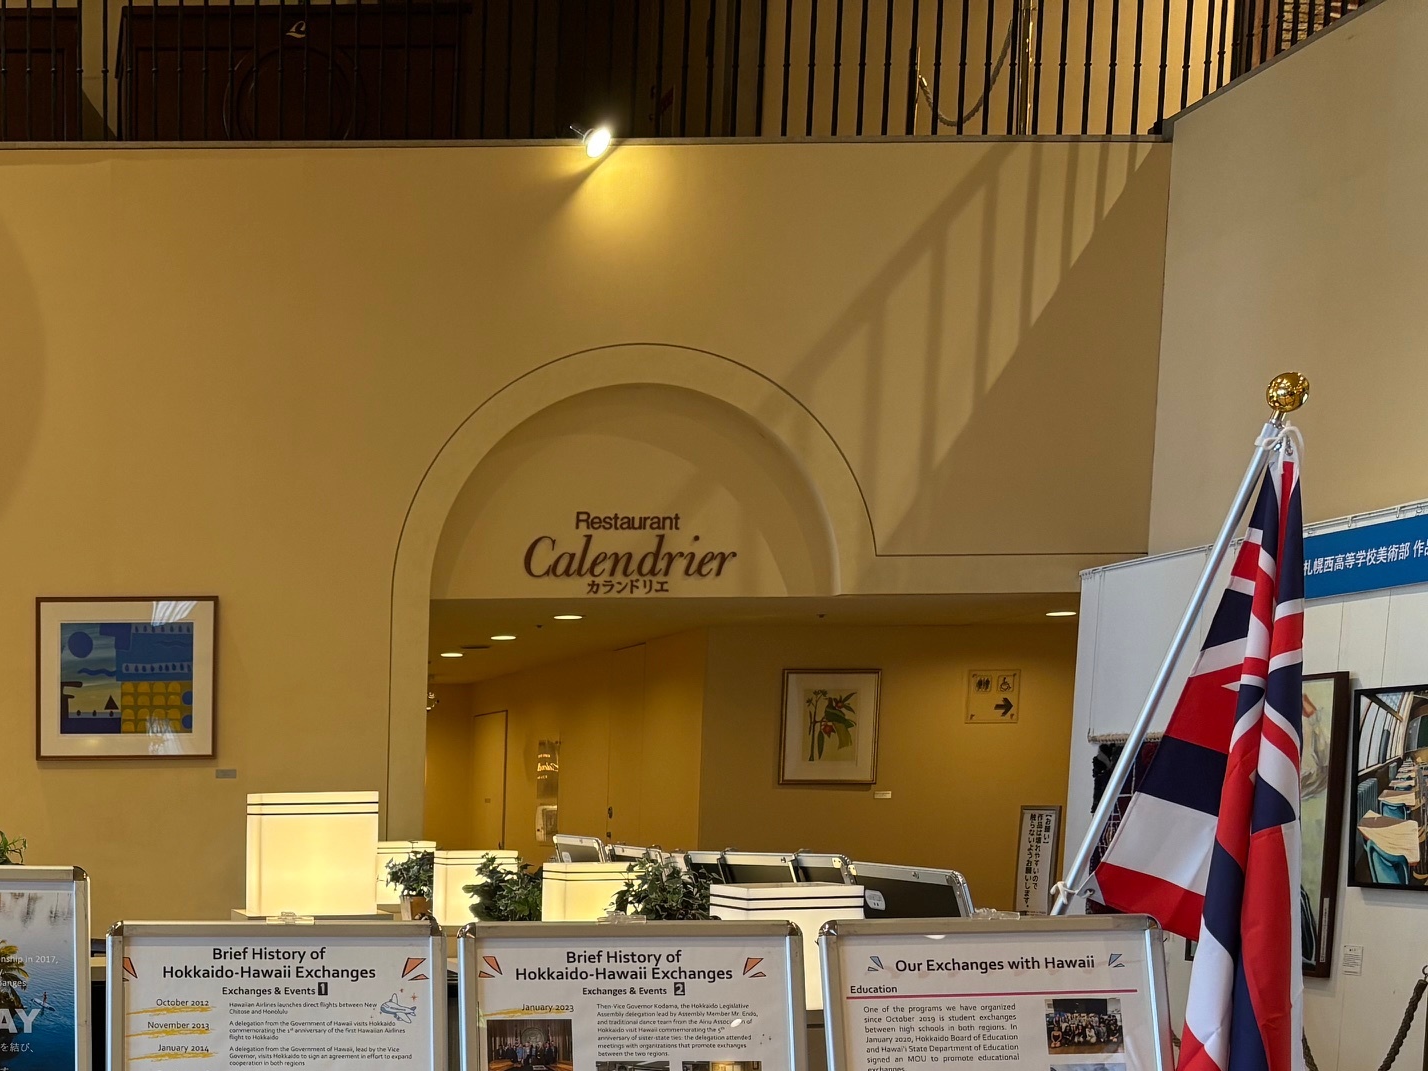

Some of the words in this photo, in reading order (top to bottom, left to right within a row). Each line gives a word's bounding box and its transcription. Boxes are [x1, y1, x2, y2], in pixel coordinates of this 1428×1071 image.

[575, 511, 680, 531] Restaurant
[523, 534, 737, 578] Calendrier
[586, 579, 669, 595] カランドリエ
[25, 955, 33, 963] in
[35, 955, 59, 964] 2017,
[212, 946, 248, 960] Brief
[251, 946, 306, 964] History
[309, 946, 326, 959] of
[566, 949, 603, 963] Brief
[606, 949, 662, 967] History
[665, 949, 682, 967] of
[894, 959, 923, 972] Our
[925, 957, 1004, 974] Exchanges
[1006, 956, 1040, 969] with
[1044, 954, 1094, 969] Hawaii
[162, 964, 291, 978] Hokkaido-Hawaii
[295, 964, 376, 983] Exchanges
[515, 966, 646, 980] Hokkaido-Hawaii
[651, 966, 733, 983] Exchanges
[221, 985, 272, 997] Exchanges
[273, 986, 281, 995] &
[283, 986, 315, 995] Events
[582, 986, 627, 996] Exchanges
[628, 986, 636, 995] &
[638, 986, 667, 995] Events
[675, 983, 684, 995] 2
[849, 984, 897, 996] Education
[155, 998, 188, 1006] October
[521, 1003, 553, 1012] January
[554, 1004, 574, 1012] 2023
[147, 1020, 189, 1031] November
[191, 1022, 209, 1031] 2013
[157, 1043, 188, 1053] January
